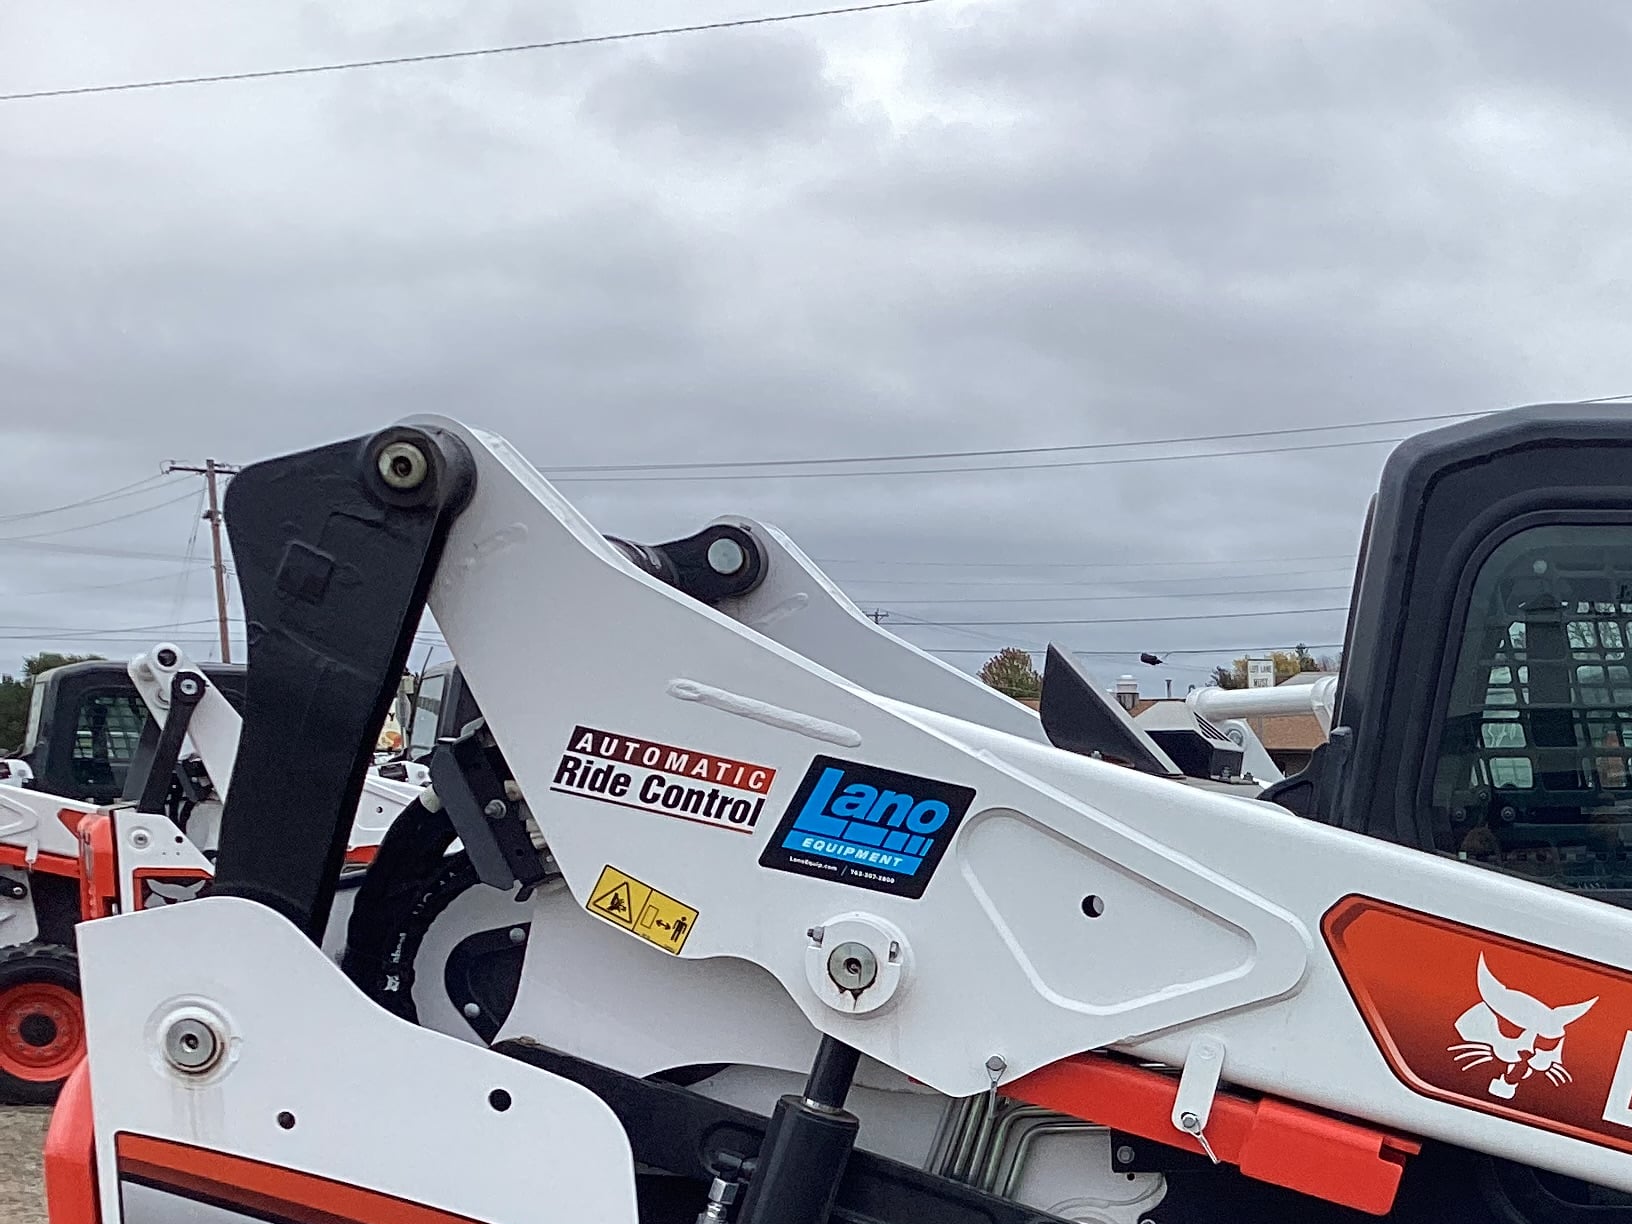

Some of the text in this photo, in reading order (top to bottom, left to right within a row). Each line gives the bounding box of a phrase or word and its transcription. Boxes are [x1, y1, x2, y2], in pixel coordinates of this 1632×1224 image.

[552, 755, 766, 828] Ride Control
[575, 731, 766, 791] AUTOMATIC
[794, 768, 951, 836] Lano
[801, 838, 904, 868] EQUIPMENT
